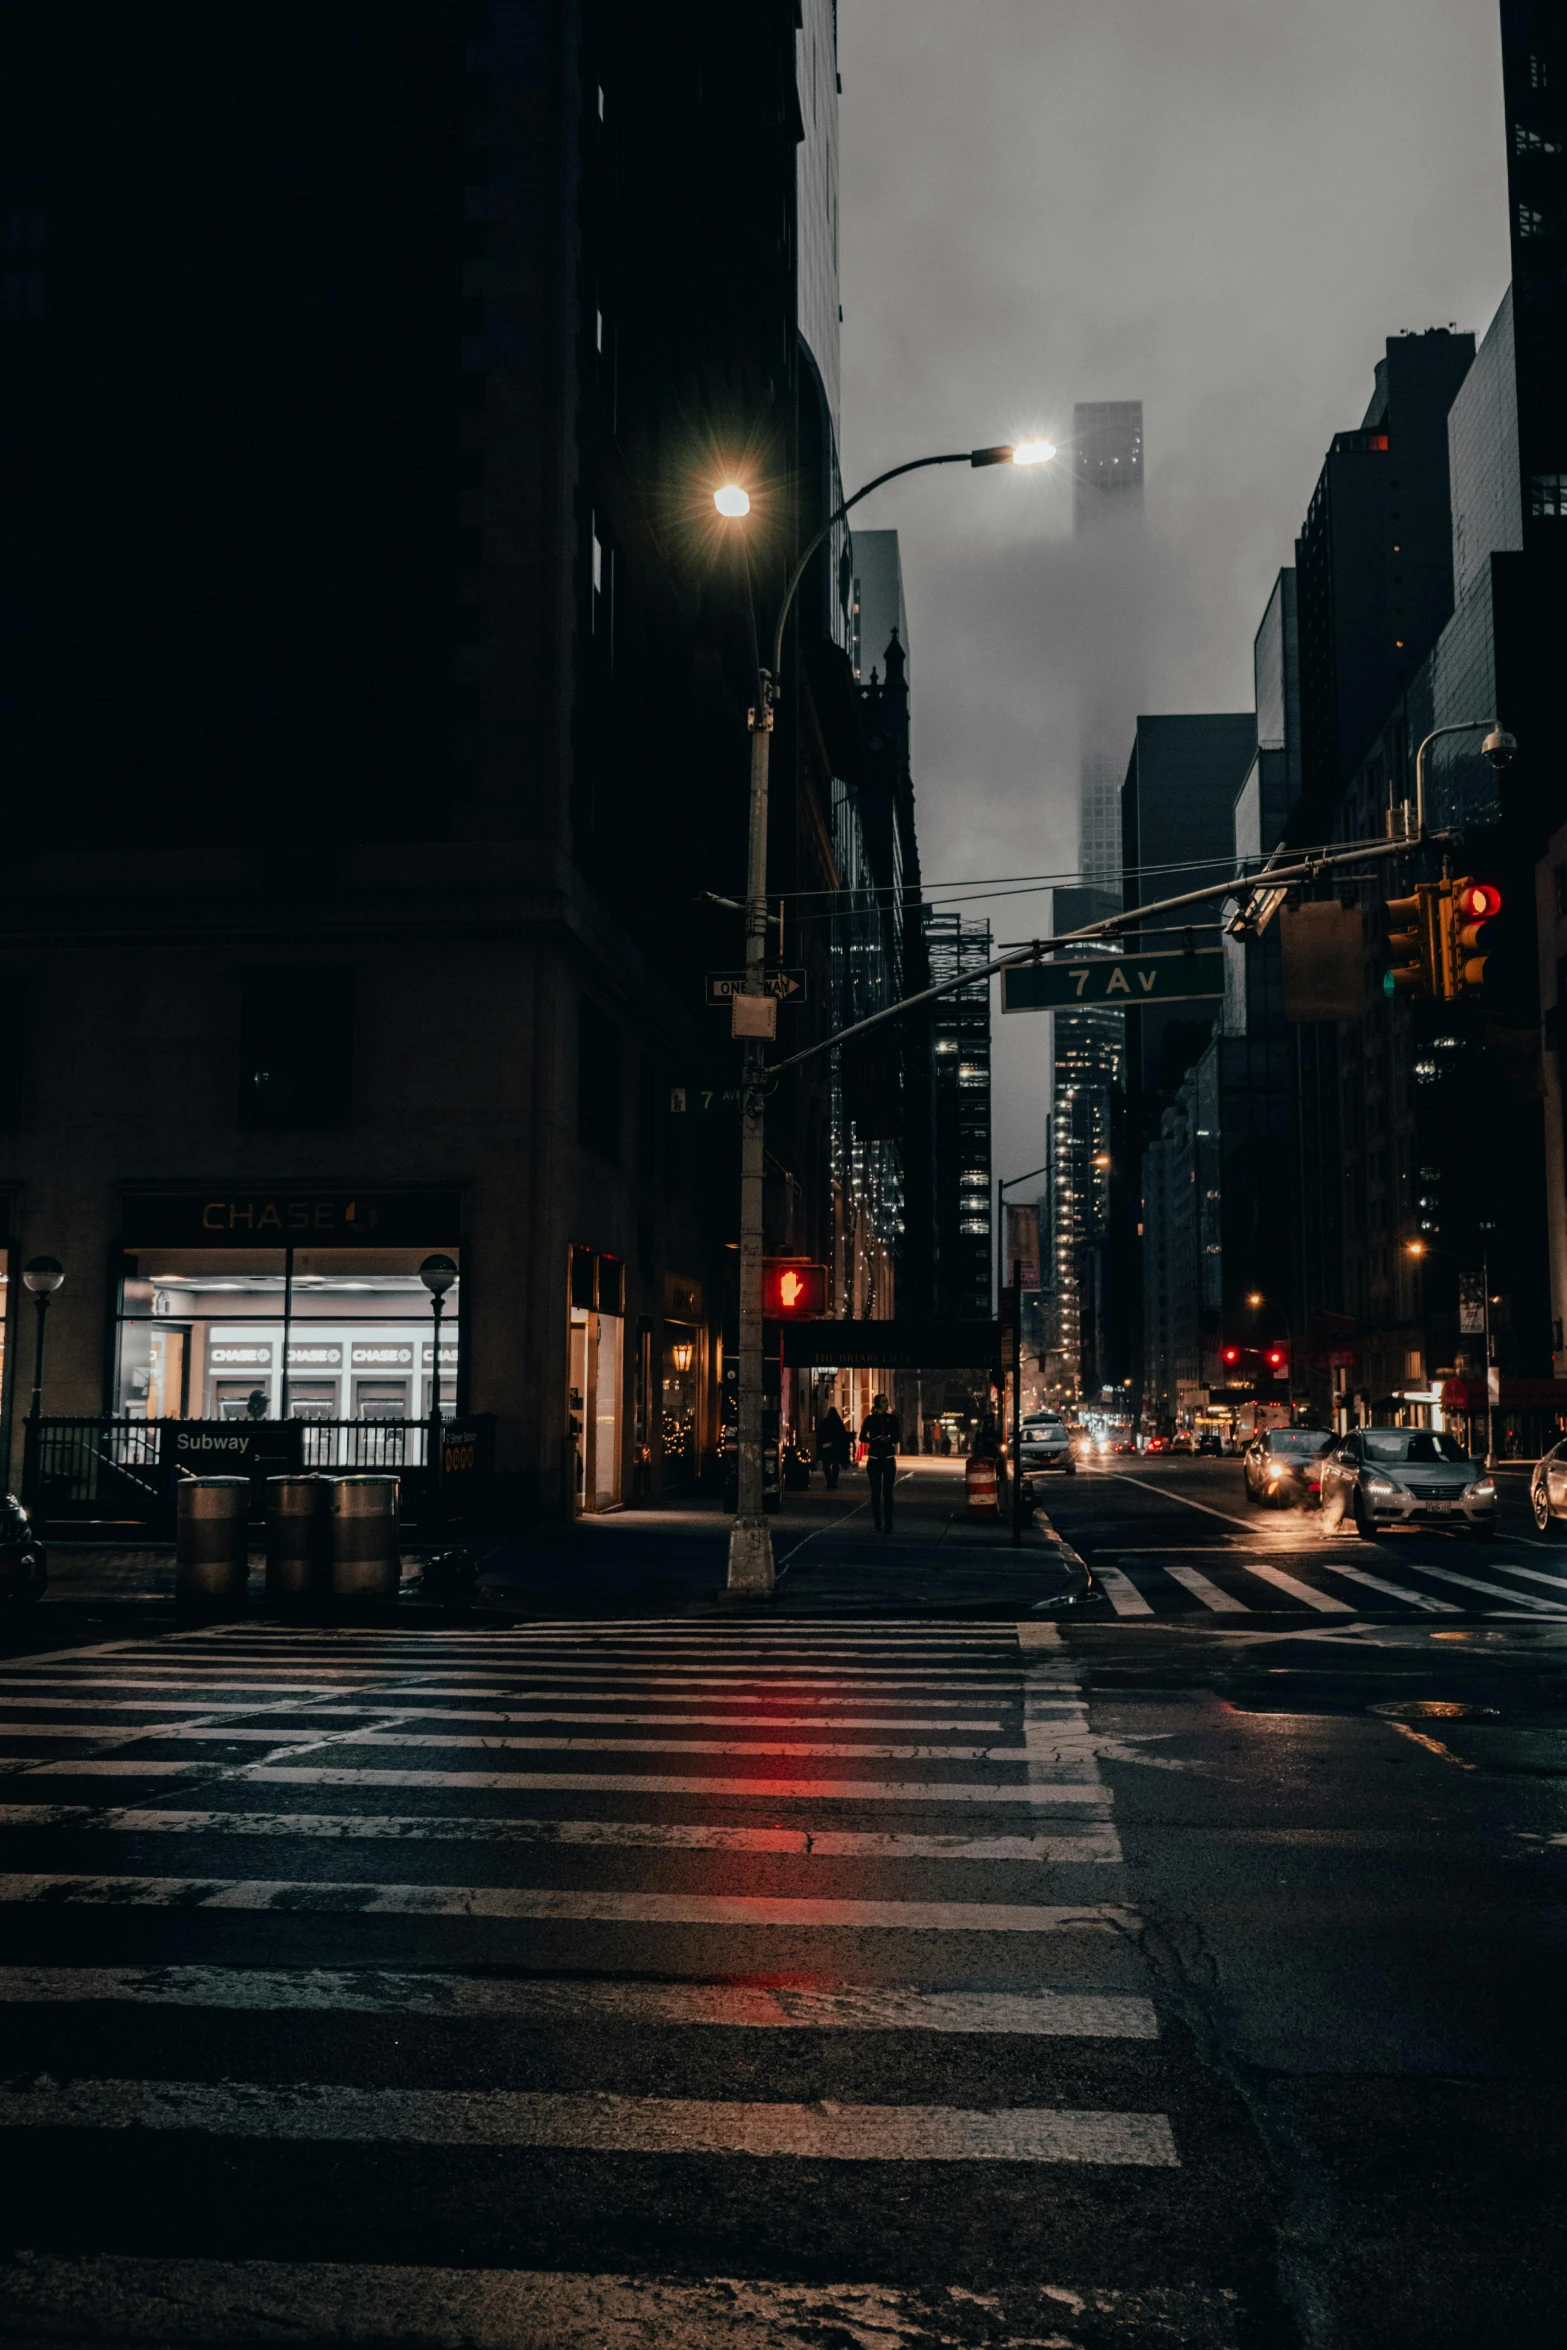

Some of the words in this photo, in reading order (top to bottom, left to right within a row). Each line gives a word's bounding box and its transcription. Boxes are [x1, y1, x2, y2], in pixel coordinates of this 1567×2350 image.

[721, 981, 745, 994] ONE
[764, 981, 790, 993] WAY
[1068, 969, 1090, 997] 7
[1105, 967, 1158, 995] Av
[700, 1090, 714, 1110] 7
[202, 1202, 336, 1230] CHASE
[212, 1349, 257, 1362] CHASE
[352, 1349, 398, 1362] CHASE
[814, 1352, 835, 1363] THE
[176, 1433, 250, 1454] Subway
